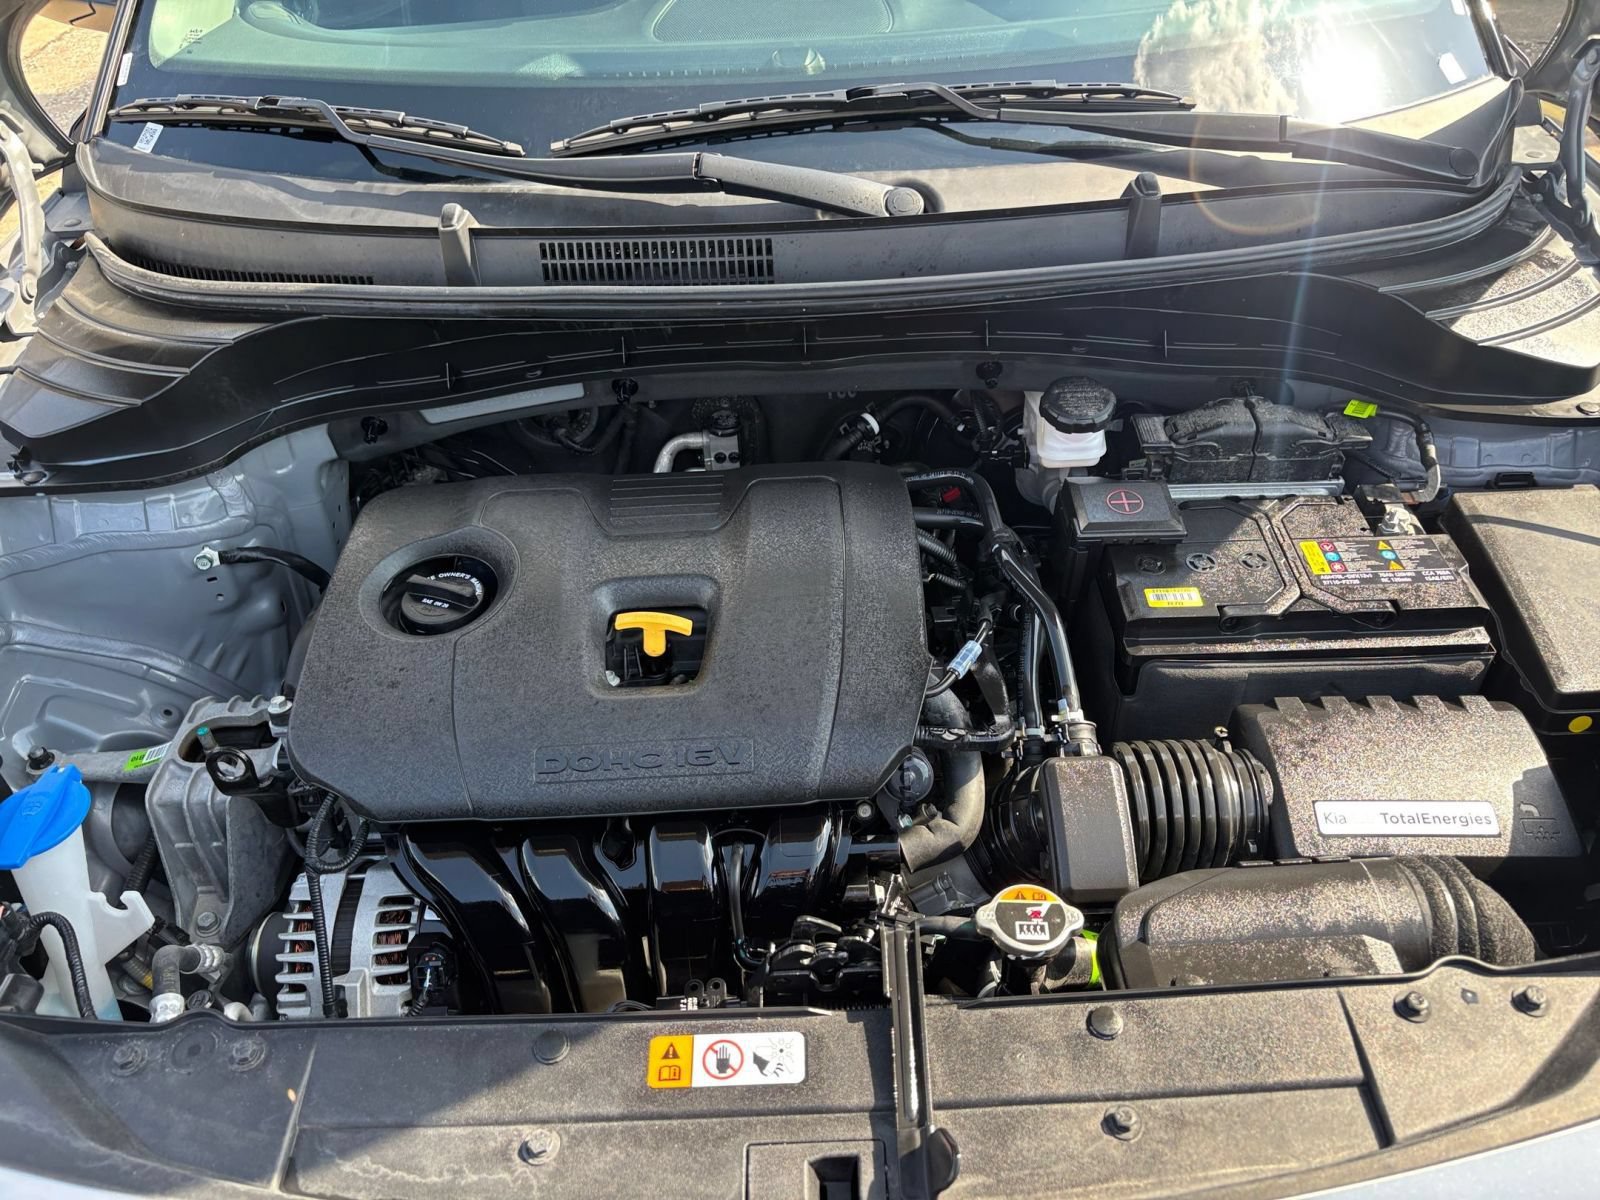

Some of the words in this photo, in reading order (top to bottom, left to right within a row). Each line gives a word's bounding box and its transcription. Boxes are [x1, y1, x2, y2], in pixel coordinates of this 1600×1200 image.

[438, 571, 472, 580] OWNER'S
[537, 749, 662, 775] DOHC
[674, 742, 747, 768] 16V
[1323, 812, 1347, 825] Kia
[1380, 811, 1492, 827] TotalEnergies
